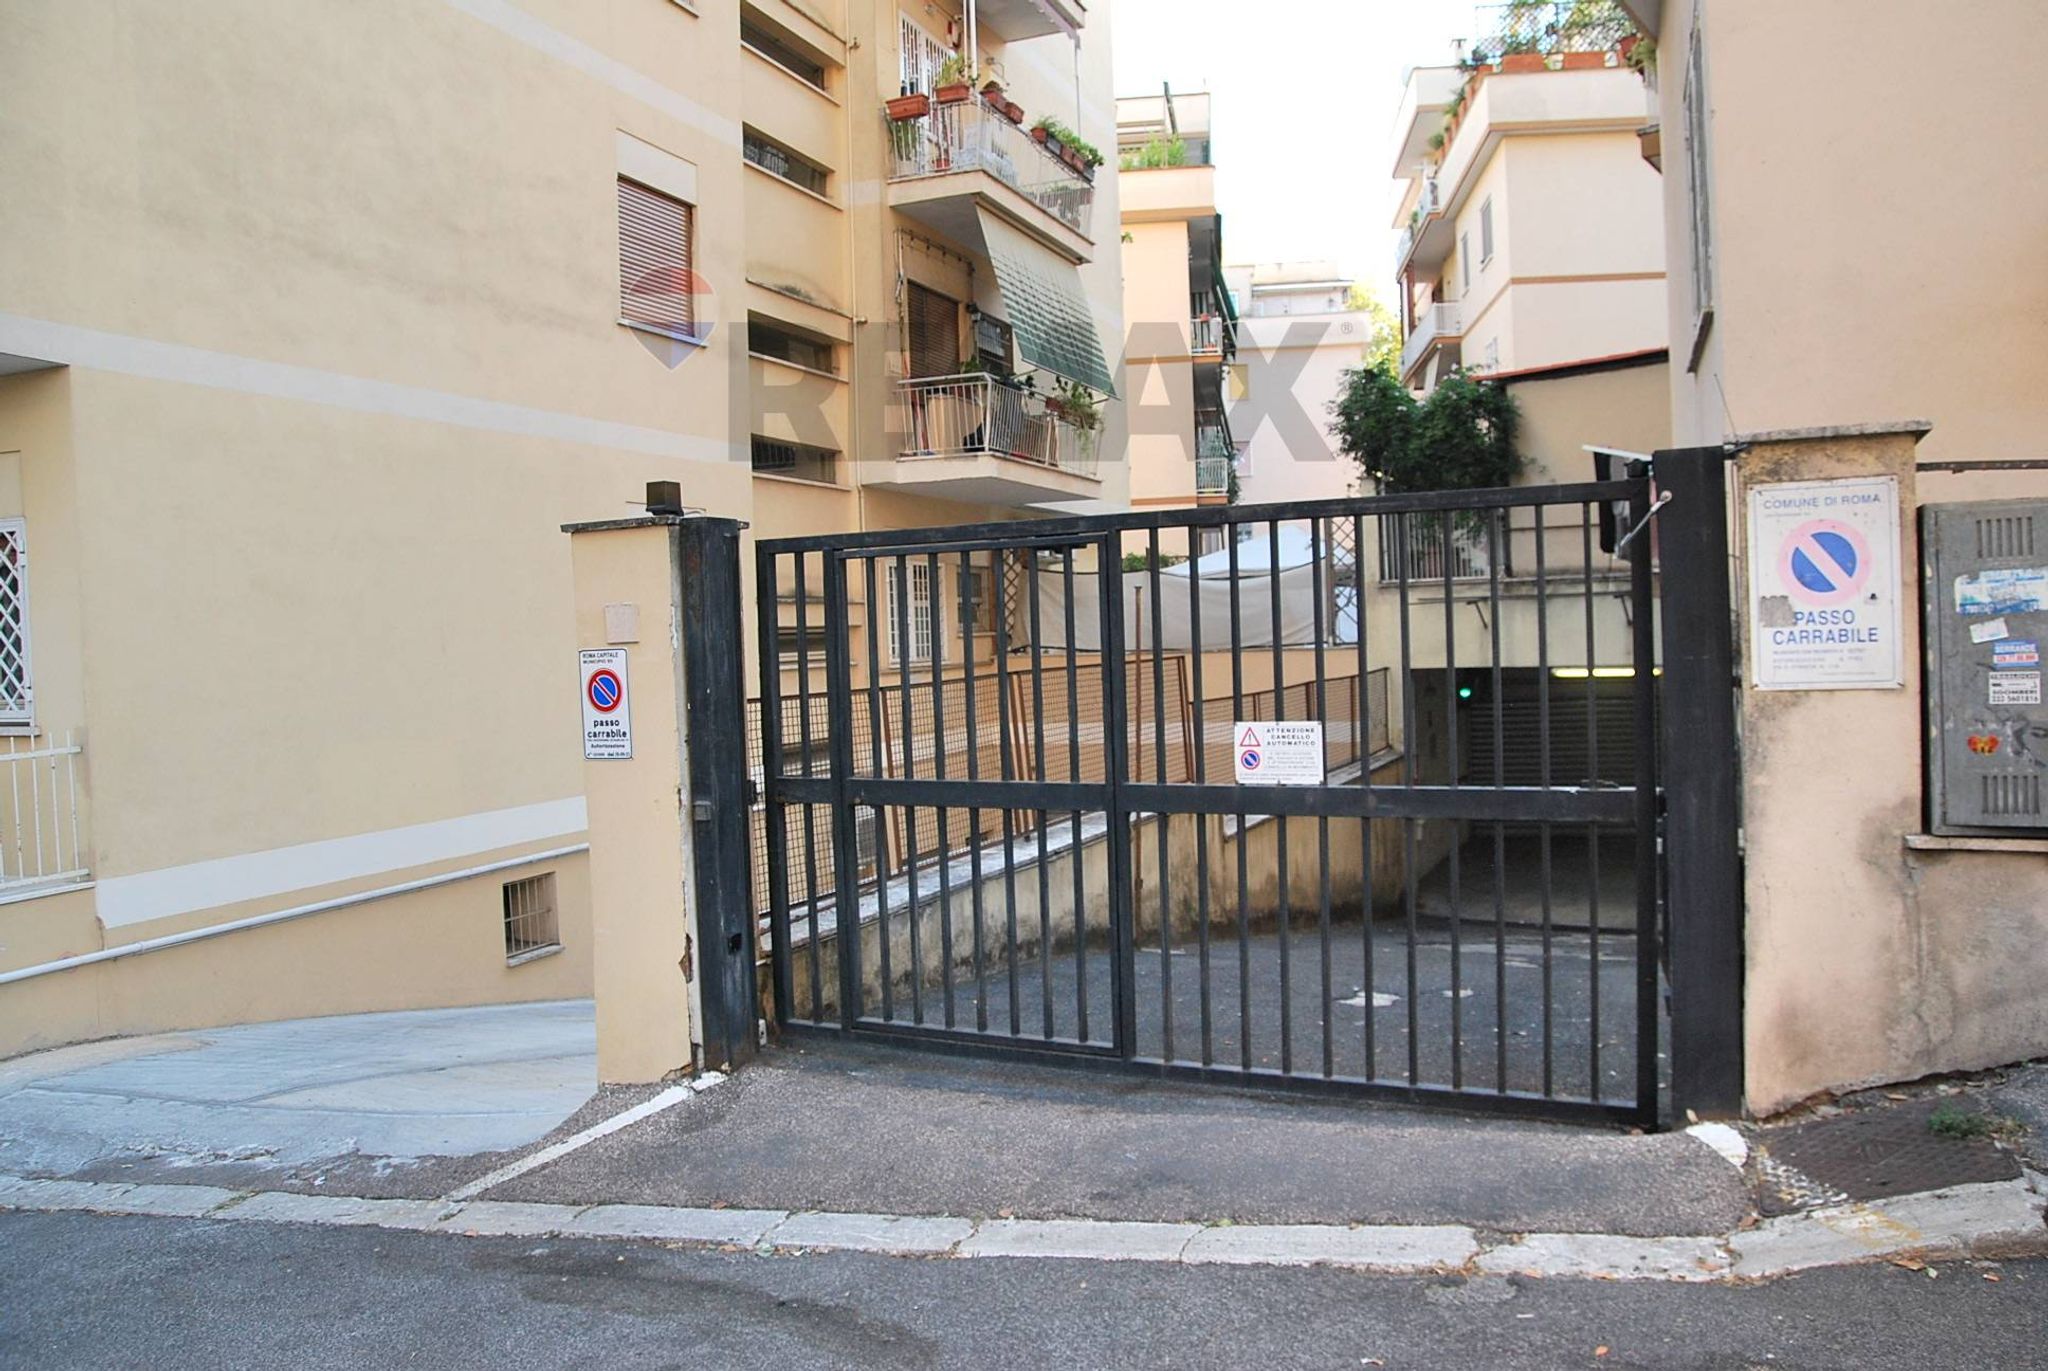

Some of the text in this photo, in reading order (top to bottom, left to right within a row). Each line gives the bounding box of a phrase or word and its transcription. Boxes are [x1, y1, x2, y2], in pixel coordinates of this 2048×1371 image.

[1763, 494, 1881, 510] COMUNE DI ROMA
[1793, 609, 1855, 626] PASSO
[1772, 627, 1879, 645] CARRABILE
[593, 720, 620, 728] passo
[587, 729, 627, 738] carrabile
